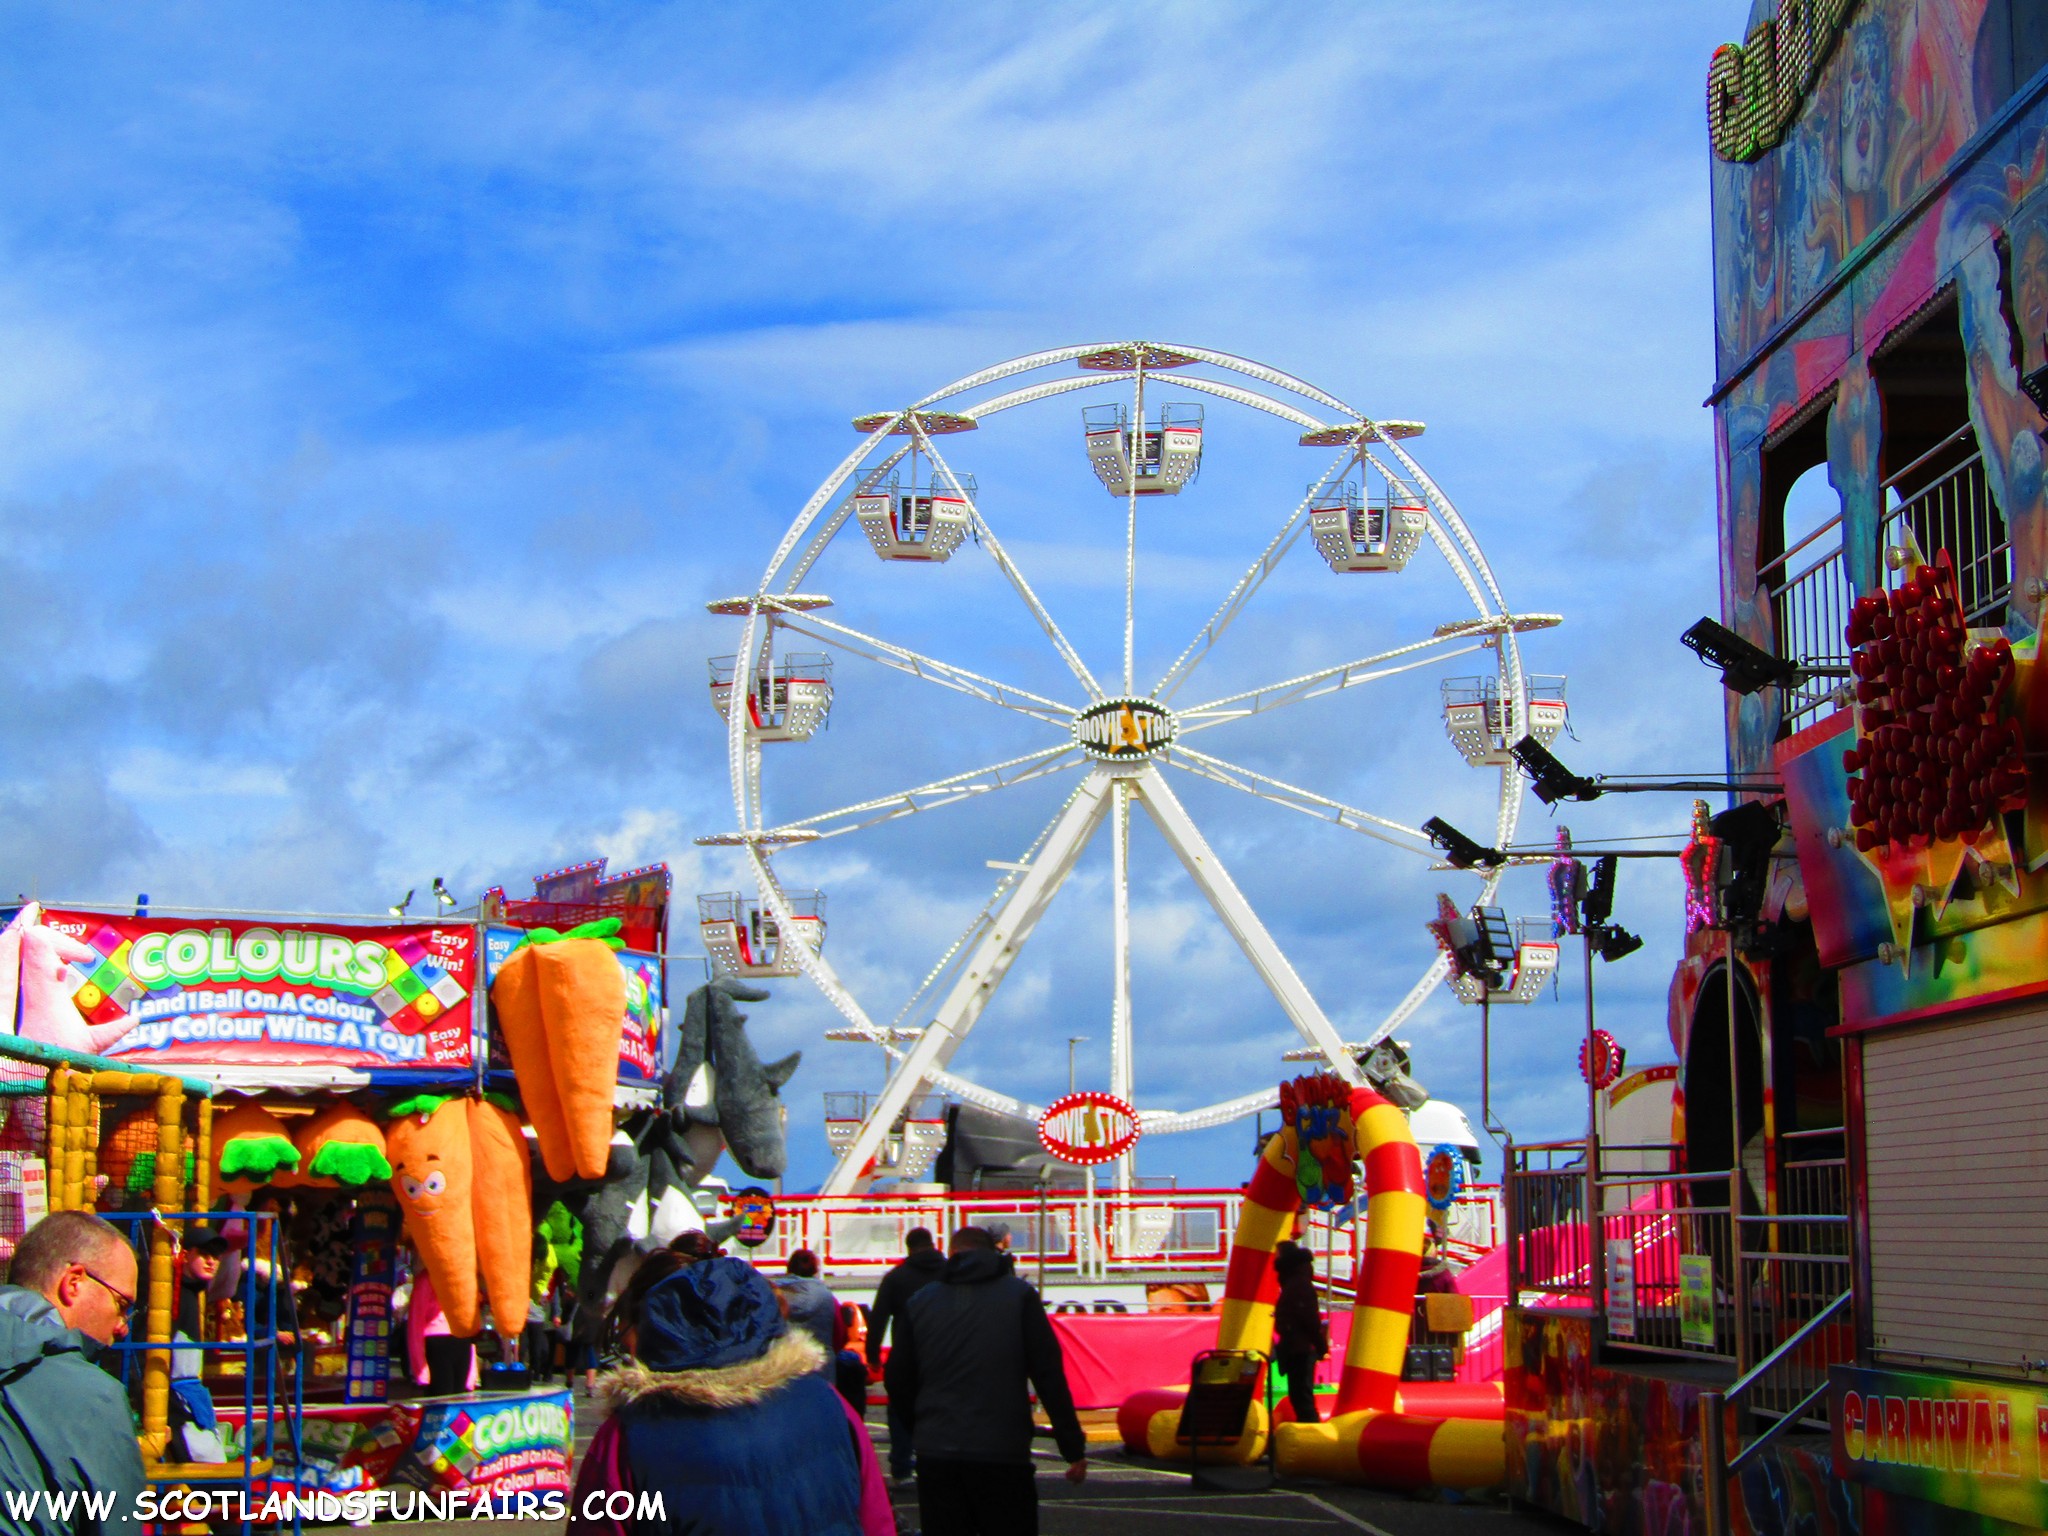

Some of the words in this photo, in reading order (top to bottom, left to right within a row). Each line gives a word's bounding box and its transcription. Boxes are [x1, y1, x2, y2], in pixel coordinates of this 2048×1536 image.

[1076, 709, 1128, 746] MOVIE
[1131, 709, 1173, 744] STAR
[49, 920, 88, 937] Easy
[430, 929, 469, 949] Easy
[487, 937, 510, 952] Easy
[129, 927, 389, 989] COLOURS
[426, 953, 465, 972] Win!
[440, 944, 454, 956] To
[130, 991, 187, 1018] Land
[188, 990, 197, 1011] 1
[201, 989, 244, 1011] Ball
[244, 991, 279, 1011] On
[280, 992, 299, 1012] A
[299, 995, 376, 1023] Colour
[121, 1021, 170, 1047] ery
[171, 1015, 265, 1039] Colour
[266, 1014, 337, 1043] Wins
[339, 1023, 361, 1046] A
[362, 1026, 427, 1059] Toy!
[429, 1026, 462, 1043] Easy
[1044, 1105, 1091, 1149] MOVIE
[1094, 1105, 1134, 1148] STAR
[474, 1402, 568, 1452] COLOURS
[1843, 1390, 2021, 1478] CARNIVAL
